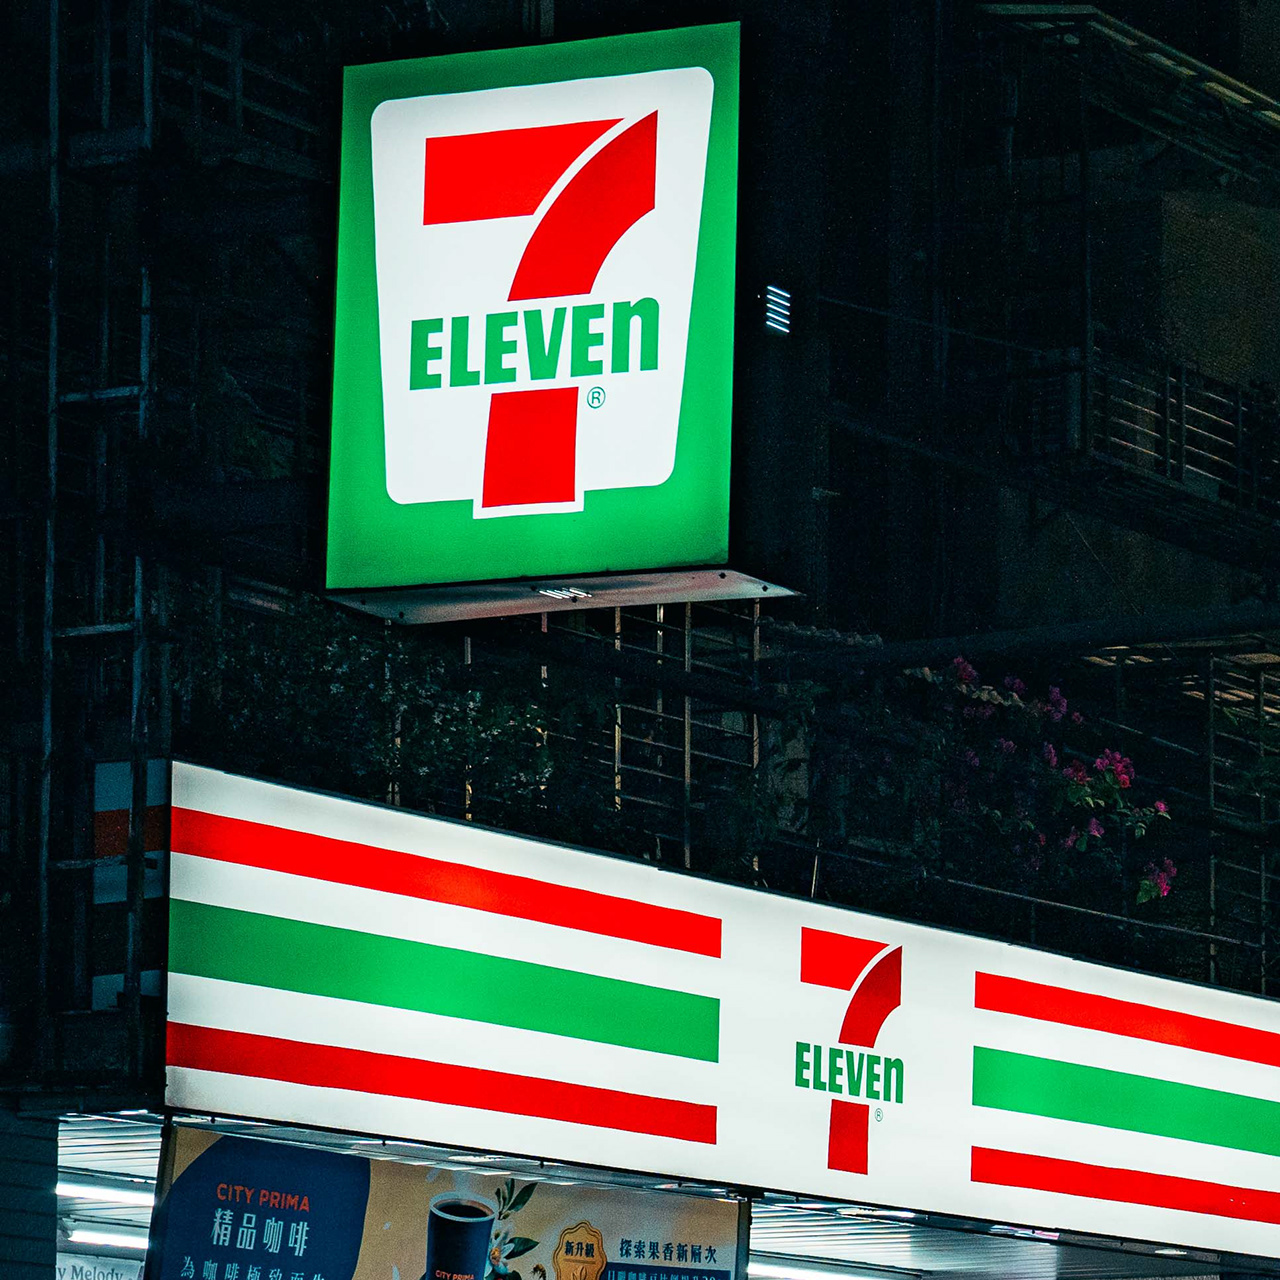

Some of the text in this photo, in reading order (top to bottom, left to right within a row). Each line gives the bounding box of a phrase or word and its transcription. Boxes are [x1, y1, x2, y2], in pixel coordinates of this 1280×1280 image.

[423, 109, 658, 509] 7
[800, 926, 903, 1176] 7
[216, 1183, 310, 1213] CITY PRIMA
[210, 1208, 311, 1257] 精品咖啡
[564, 1240, 595, 1258] 新升級
[620, 1238, 718, 1264] 探索果香新層次
[435, 1270, 451, 1280] CITY
